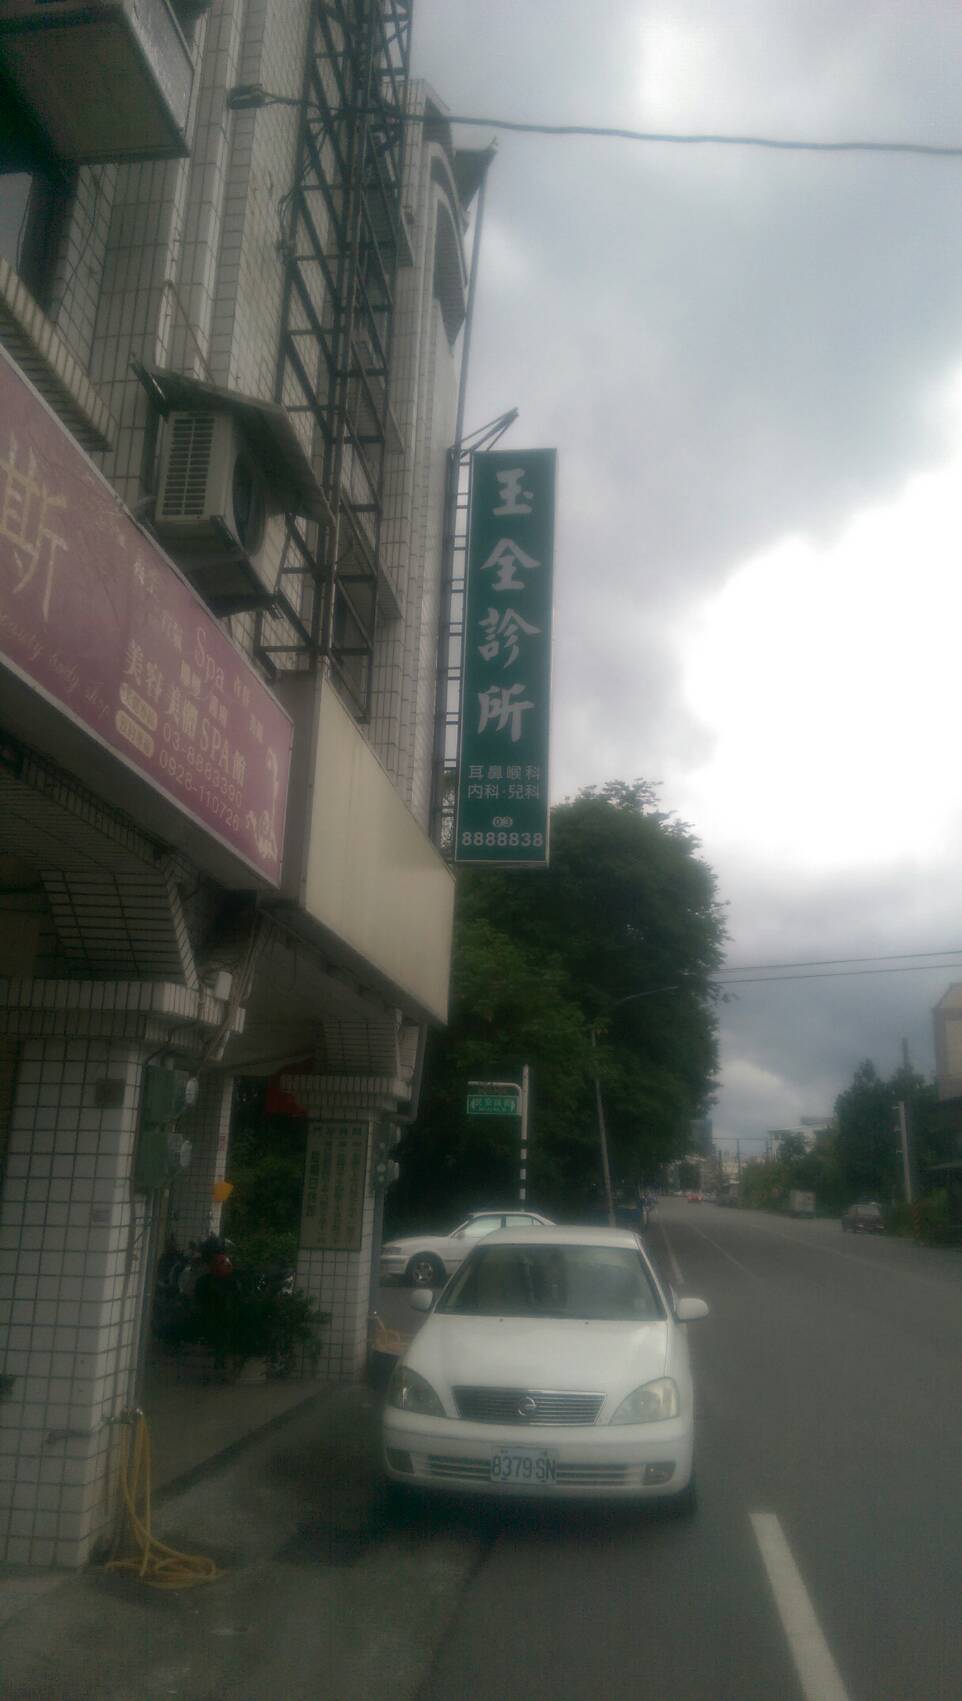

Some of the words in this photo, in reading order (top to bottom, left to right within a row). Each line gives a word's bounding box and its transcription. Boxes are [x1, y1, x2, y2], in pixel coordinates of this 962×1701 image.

[477, 467, 543, 743] 玉全診所
[468, 765, 541, 780] 耳鼻喉科
[461, 831, 544, 847] 8888838
